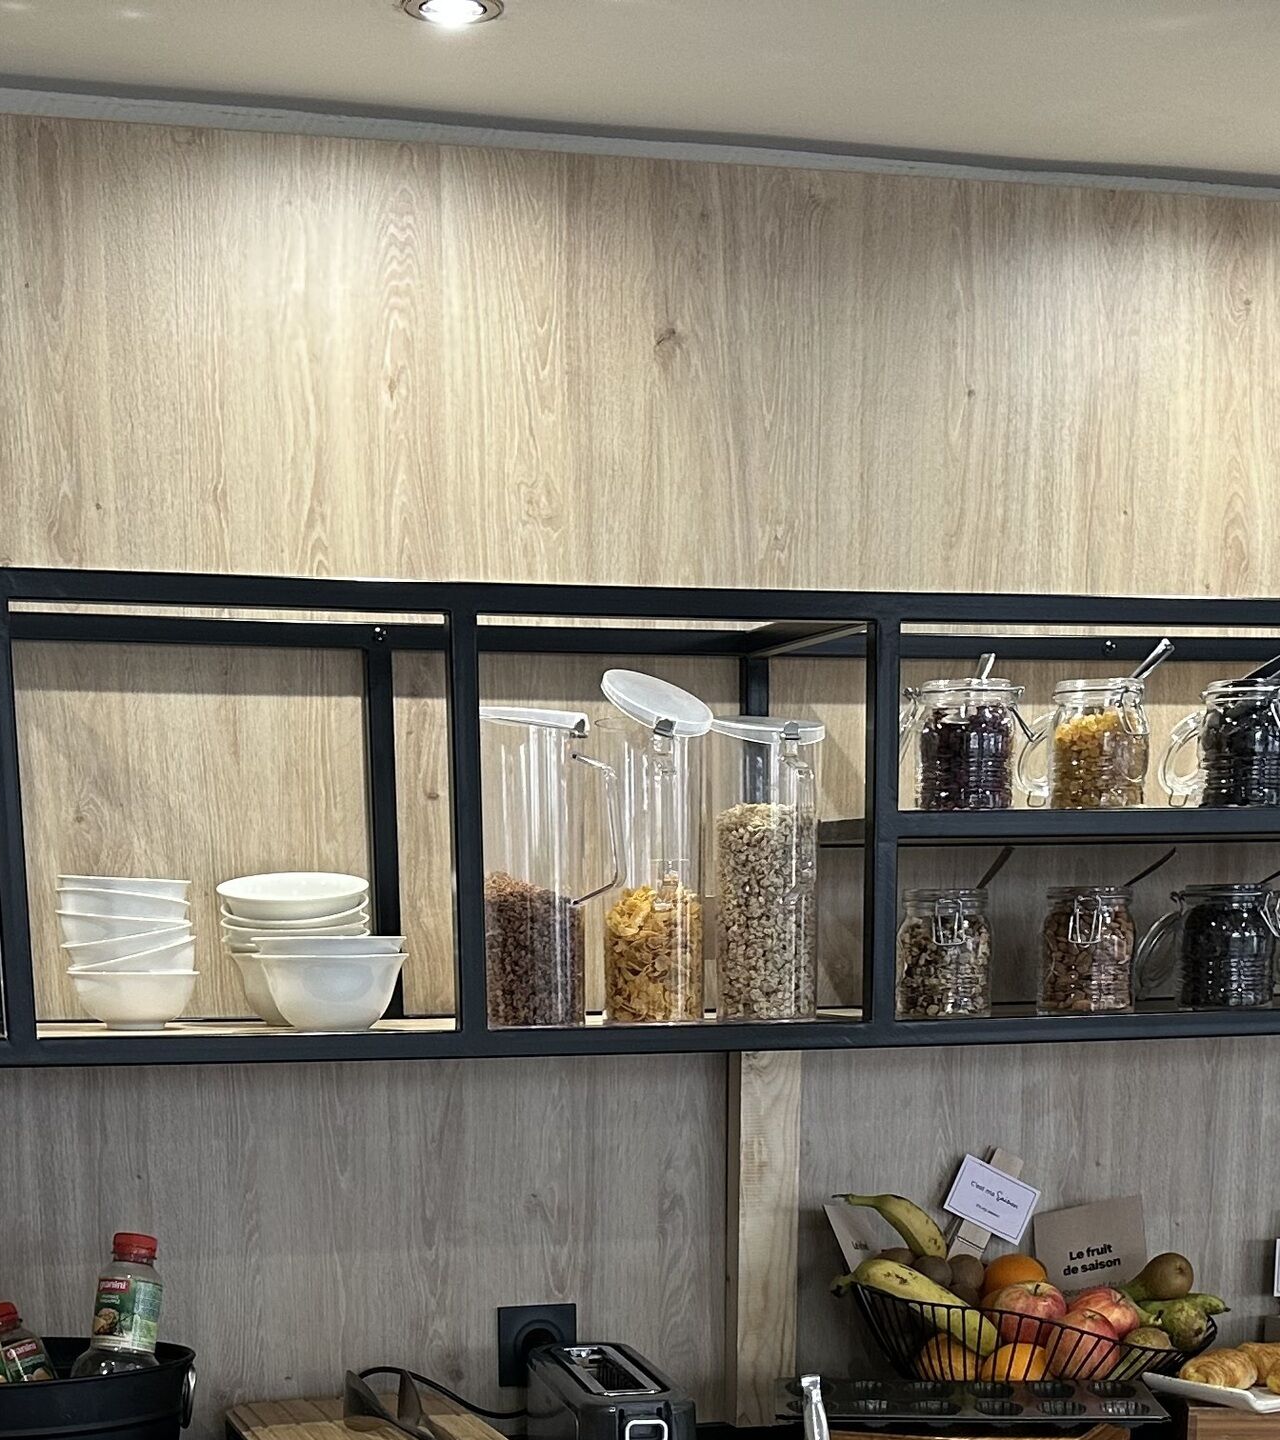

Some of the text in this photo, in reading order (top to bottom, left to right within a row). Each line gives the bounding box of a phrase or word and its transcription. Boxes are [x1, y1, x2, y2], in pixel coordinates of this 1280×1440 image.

[1069, 1244, 1112, 1261] Le fruit
[1063, 1257, 1121, 1276] de saison
